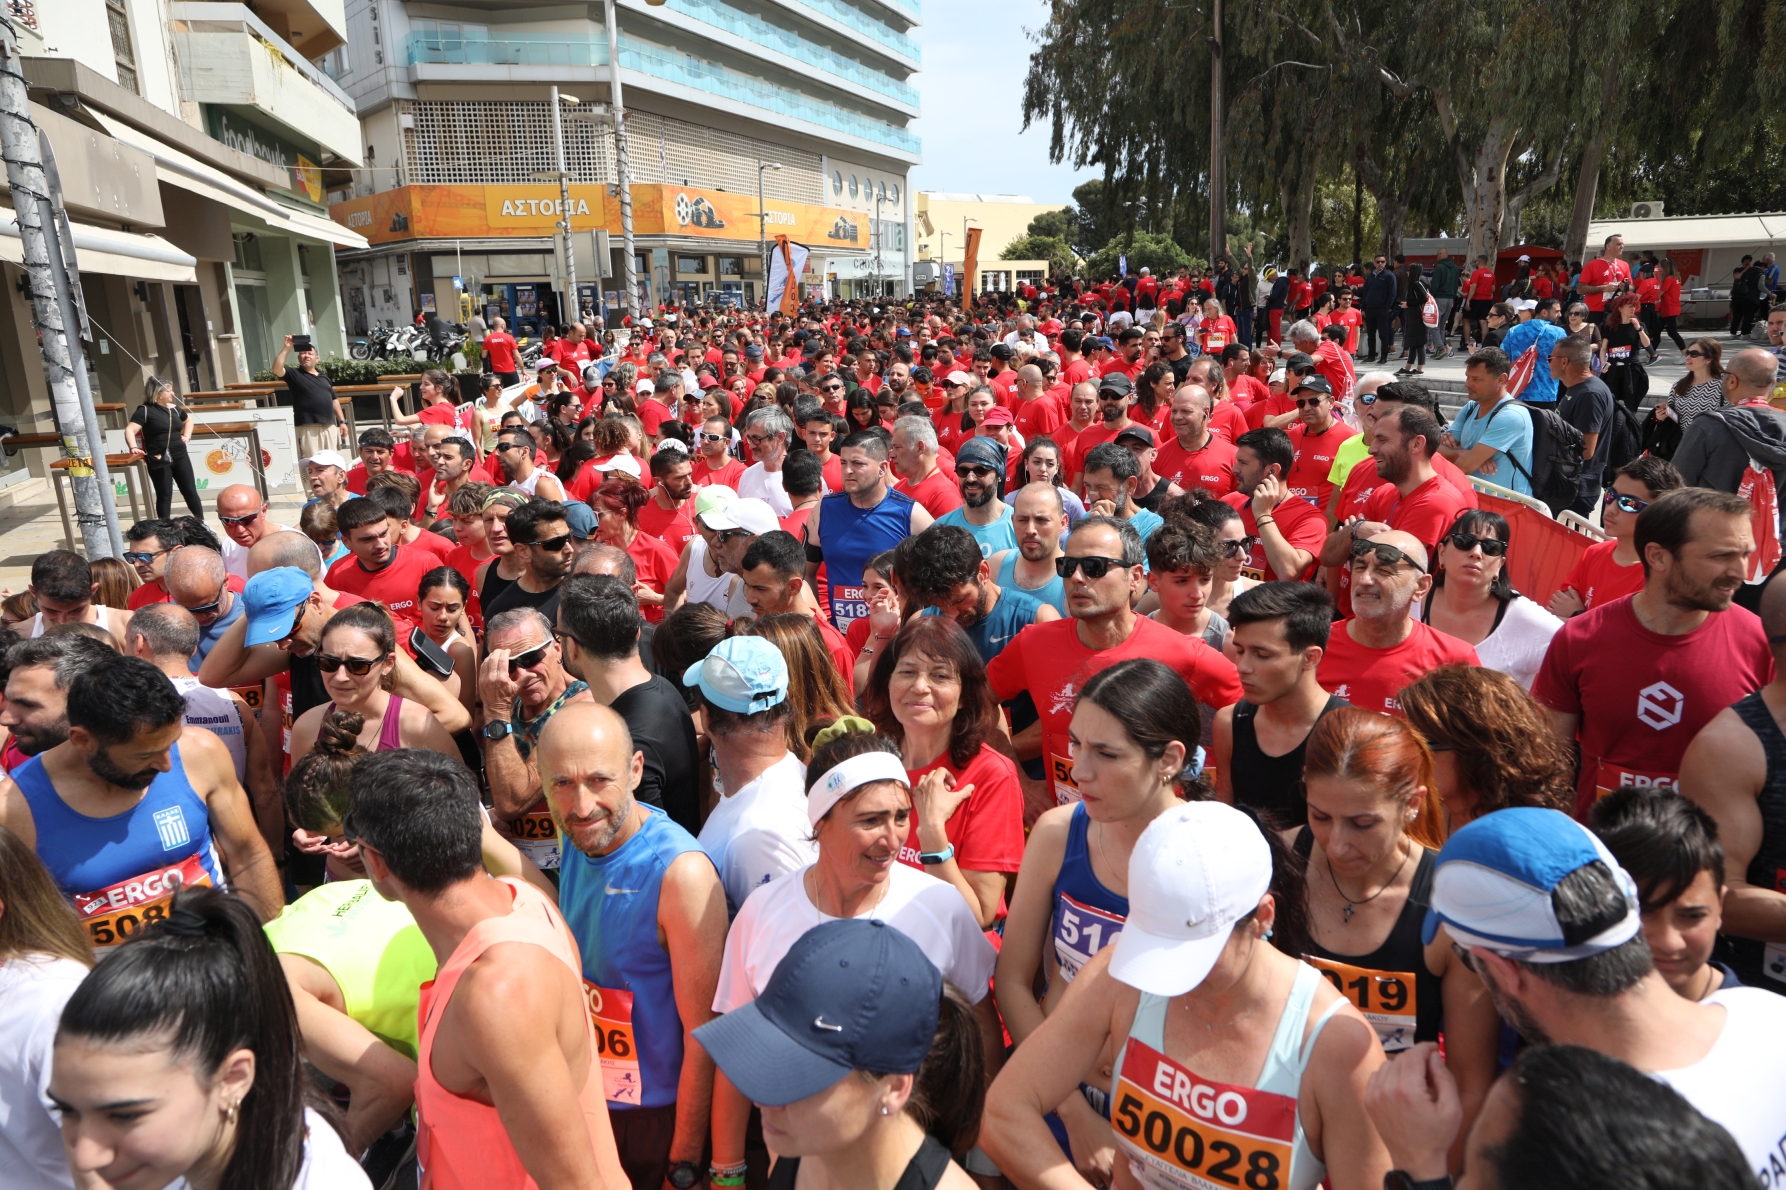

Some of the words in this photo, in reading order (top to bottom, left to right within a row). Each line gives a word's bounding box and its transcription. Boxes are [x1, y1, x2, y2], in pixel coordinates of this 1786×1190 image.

[347, 209, 373, 230] ΑΣΤΟΡΙΑ
[1313, 454, 1330, 462] ERGO
[390, 600, 413, 611] ERGO
[835, 602, 870, 617] 518
[185, 714, 230, 724] Emmanouil
[510, 817, 555, 838] 029
[107, 868, 184, 908] ERGO
[331, 883, 370, 918] HERBALIF
[1153, 1060, 1248, 1126] ERGO
[1115, 1093, 1280, 1190] 50028
